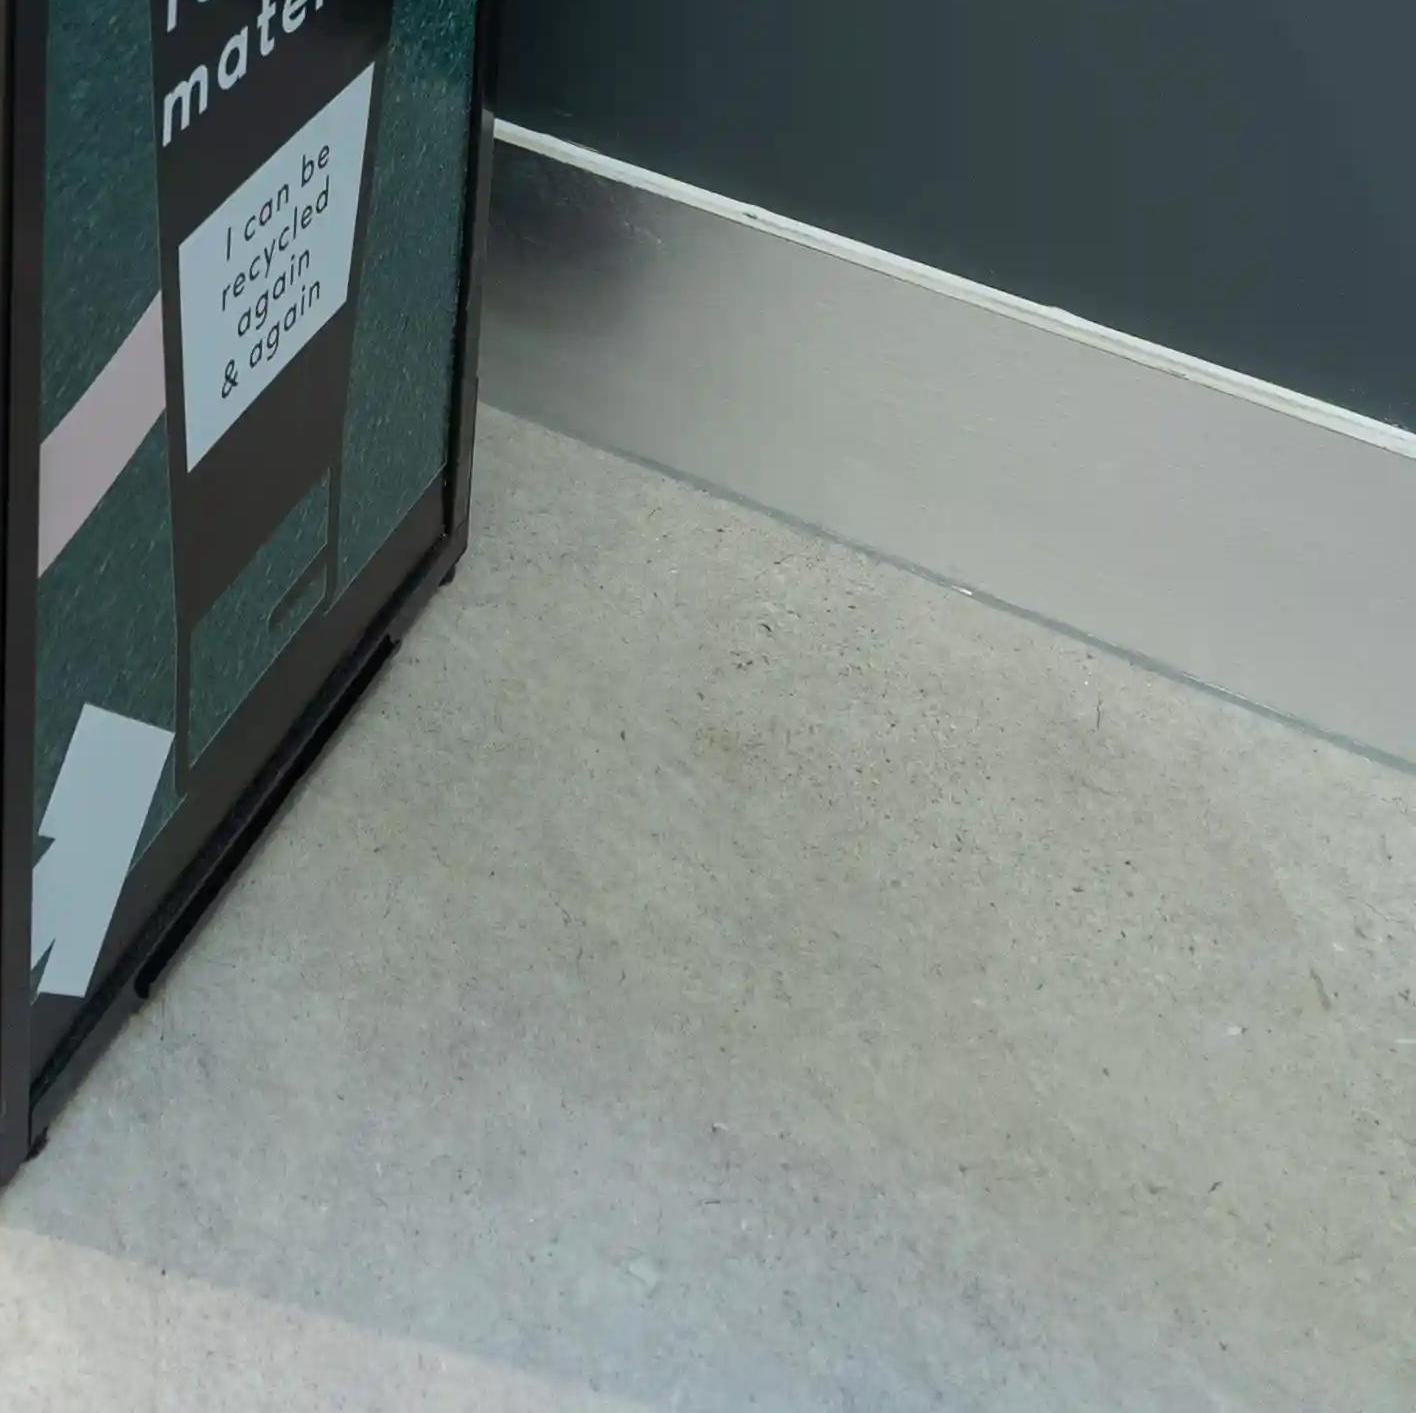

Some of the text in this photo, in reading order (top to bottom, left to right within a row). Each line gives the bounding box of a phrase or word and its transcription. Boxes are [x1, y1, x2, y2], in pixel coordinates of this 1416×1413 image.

[221, 174, 331, 312] recycled
[225, 143, 331, 262] I can be
[220, 279, 321, 400] & again
[237, 247, 311, 339] again
